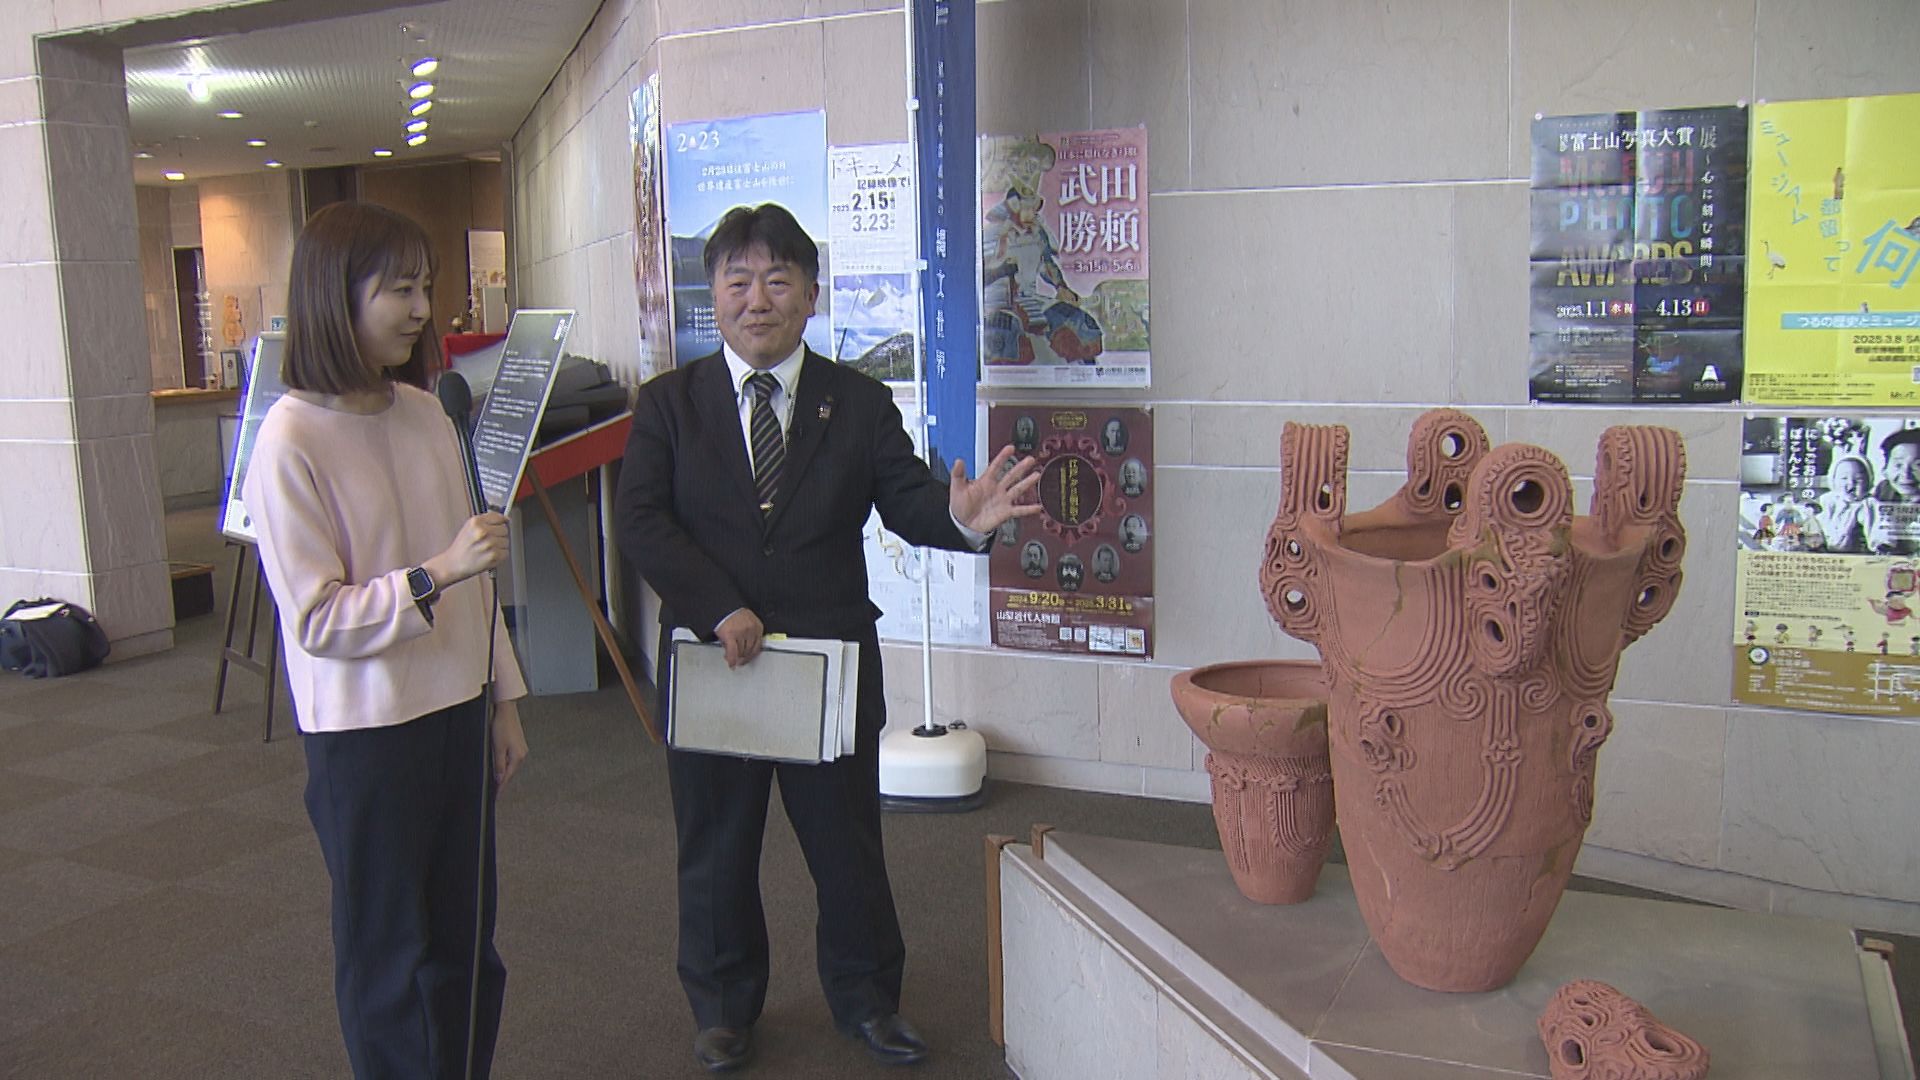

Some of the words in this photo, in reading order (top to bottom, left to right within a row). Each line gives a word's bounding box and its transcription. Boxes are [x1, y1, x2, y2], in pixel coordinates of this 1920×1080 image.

[1059, 163, 1137, 206] 武田
[852, 191, 889, 212] 2.15
[852, 213, 889, 232] 3.23
[1058, 208, 1140, 253] 勝頼
